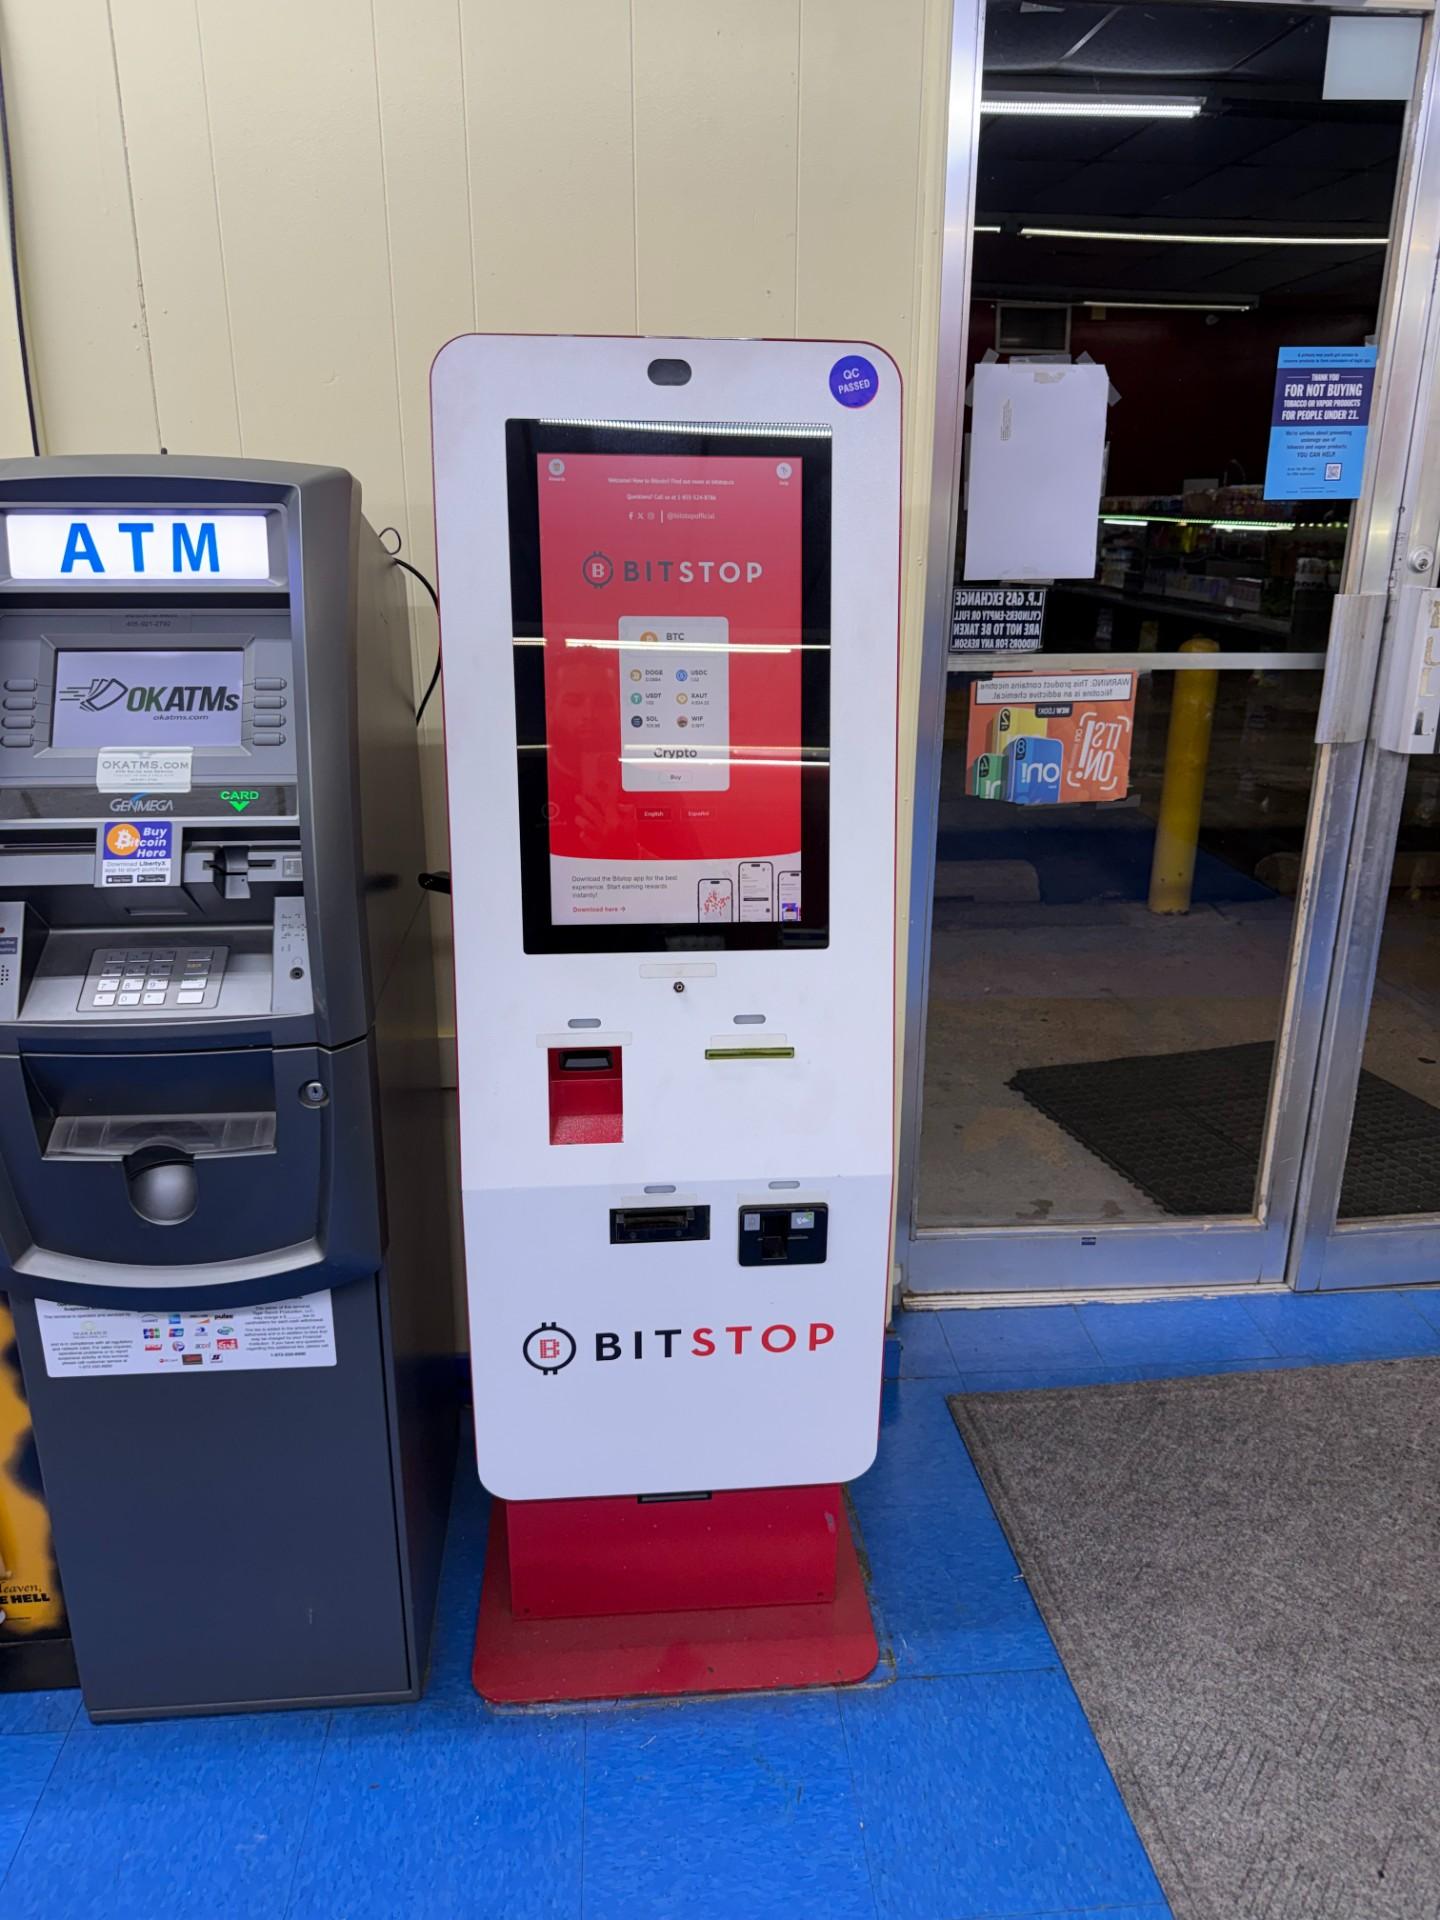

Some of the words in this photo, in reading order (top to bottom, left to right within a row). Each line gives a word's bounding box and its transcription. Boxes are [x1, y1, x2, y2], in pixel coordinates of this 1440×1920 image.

[843, 368, 860, 380] QC
[1312, 373, 1328, 381] THANK
[1329, 373, 1340, 381] YOU
[838, 379, 870, 394] PASSED
[1285, 384, 1304, 397] FOR
[1306, 384, 1326, 397] NOT
[1327, 383, 1363, 397] BUYING
[1284, 400, 1307, 408] TOBACCO
[1308, 399, 1316, 407] OR
[1316, 399, 1333, 407] VAPOR
[1333, 399, 1361, 407] PRODUCTS
[1282, 411, 1296, 420] FOR
[1297, 410, 1323, 420] PEOPLE
[1324, 410, 1347, 419] UNDER
[1348, 410, 1359, 419] 21.
[60, 523, 220, 573] ATM
[624, 561, 763, 583] BITSTOP
[126, 686, 240, 712] OKATMs
[653, 747, 698, 759] Crypto
[220, 791, 259, 800] CARD
[109, 798, 174, 813] GENMEGA
[143, 827, 168, 838] Buy
[136, 849, 167, 858] Here
[595, 1322, 835, 1362] BITSTOP
[10, 1593, 51, 1603] HELL
